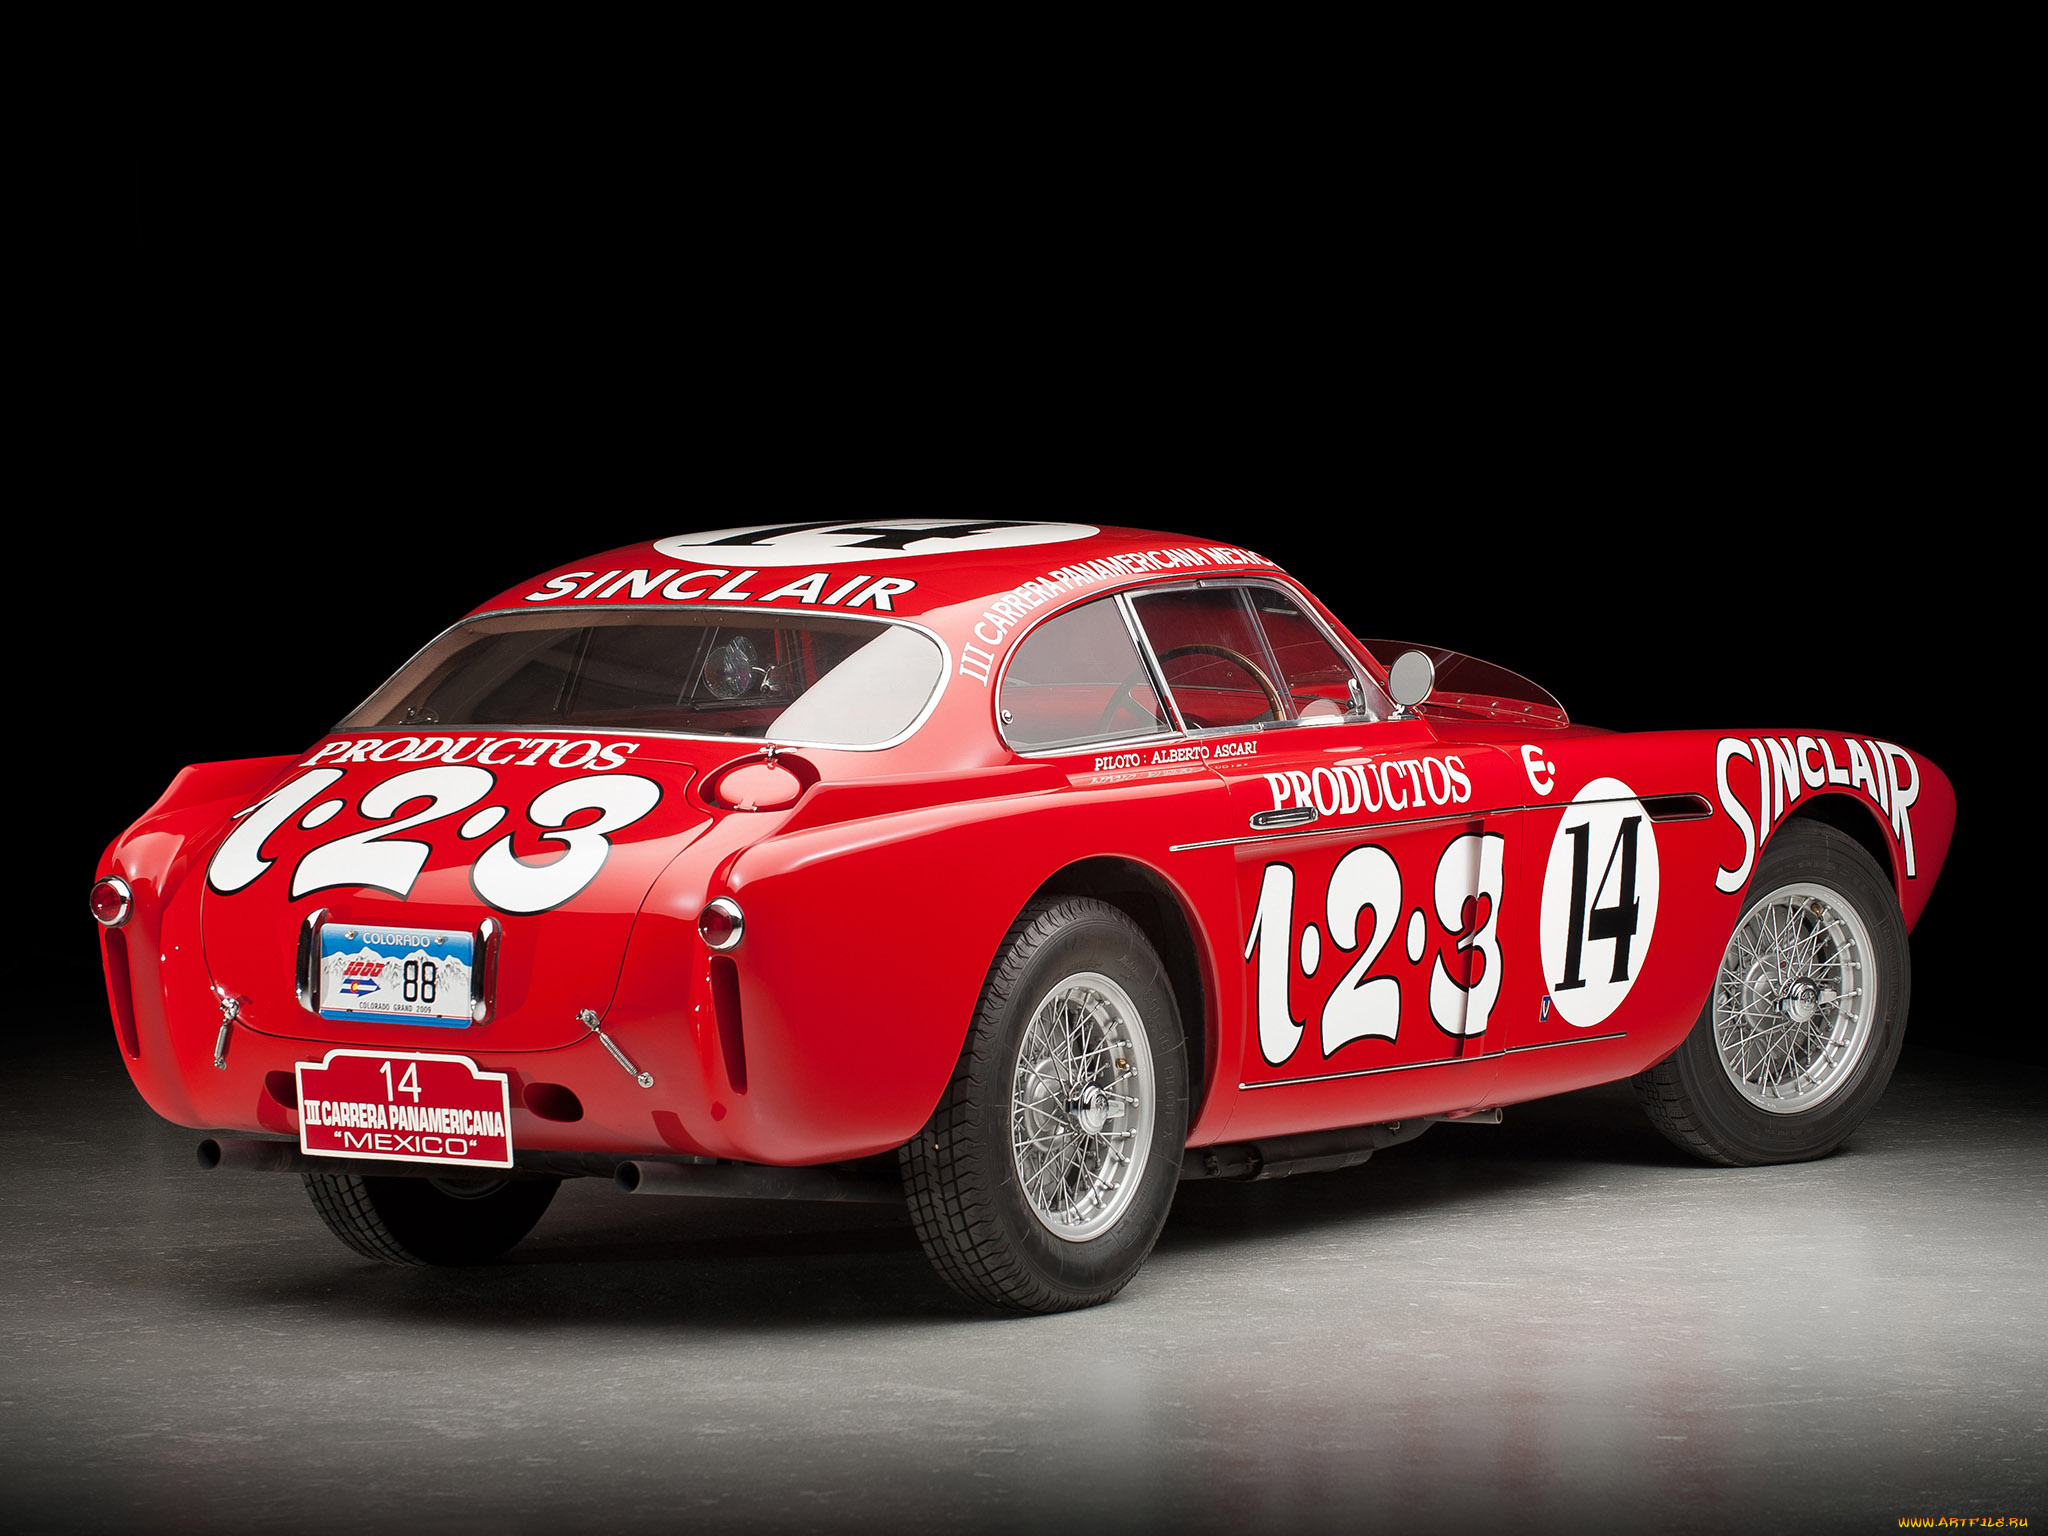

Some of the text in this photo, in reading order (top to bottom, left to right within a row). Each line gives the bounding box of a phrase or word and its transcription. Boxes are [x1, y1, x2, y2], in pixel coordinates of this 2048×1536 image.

[524, 569, 918, 611] SINCLAIR
[958, 547, 1287, 687] III CARRERA PANAMERICANA MEXIC
[299, 736, 638, 770] PRODUCTOS
[1094, 753, 1141, 772] PILOTO
[1151, 746, 1210, 765] ALBERTO
[1213, 740, 1257, 758] ASCARI
[1263, 755, 1472, 816] PRODUCTOS
[1713, 735, 1921, 895] SINCLAIR
[1553, 815, 1643, 992] 14
[362, 932, 431, 948] COLORADO
[403, 959, 437, 1004] 88
[359, 1001, 432, 1014] COLORADO GRAND 2009
[379, 1060, 422, 1103] 14
[304, 1100, 505, 1138] III CARRERA PANAMERICANA
